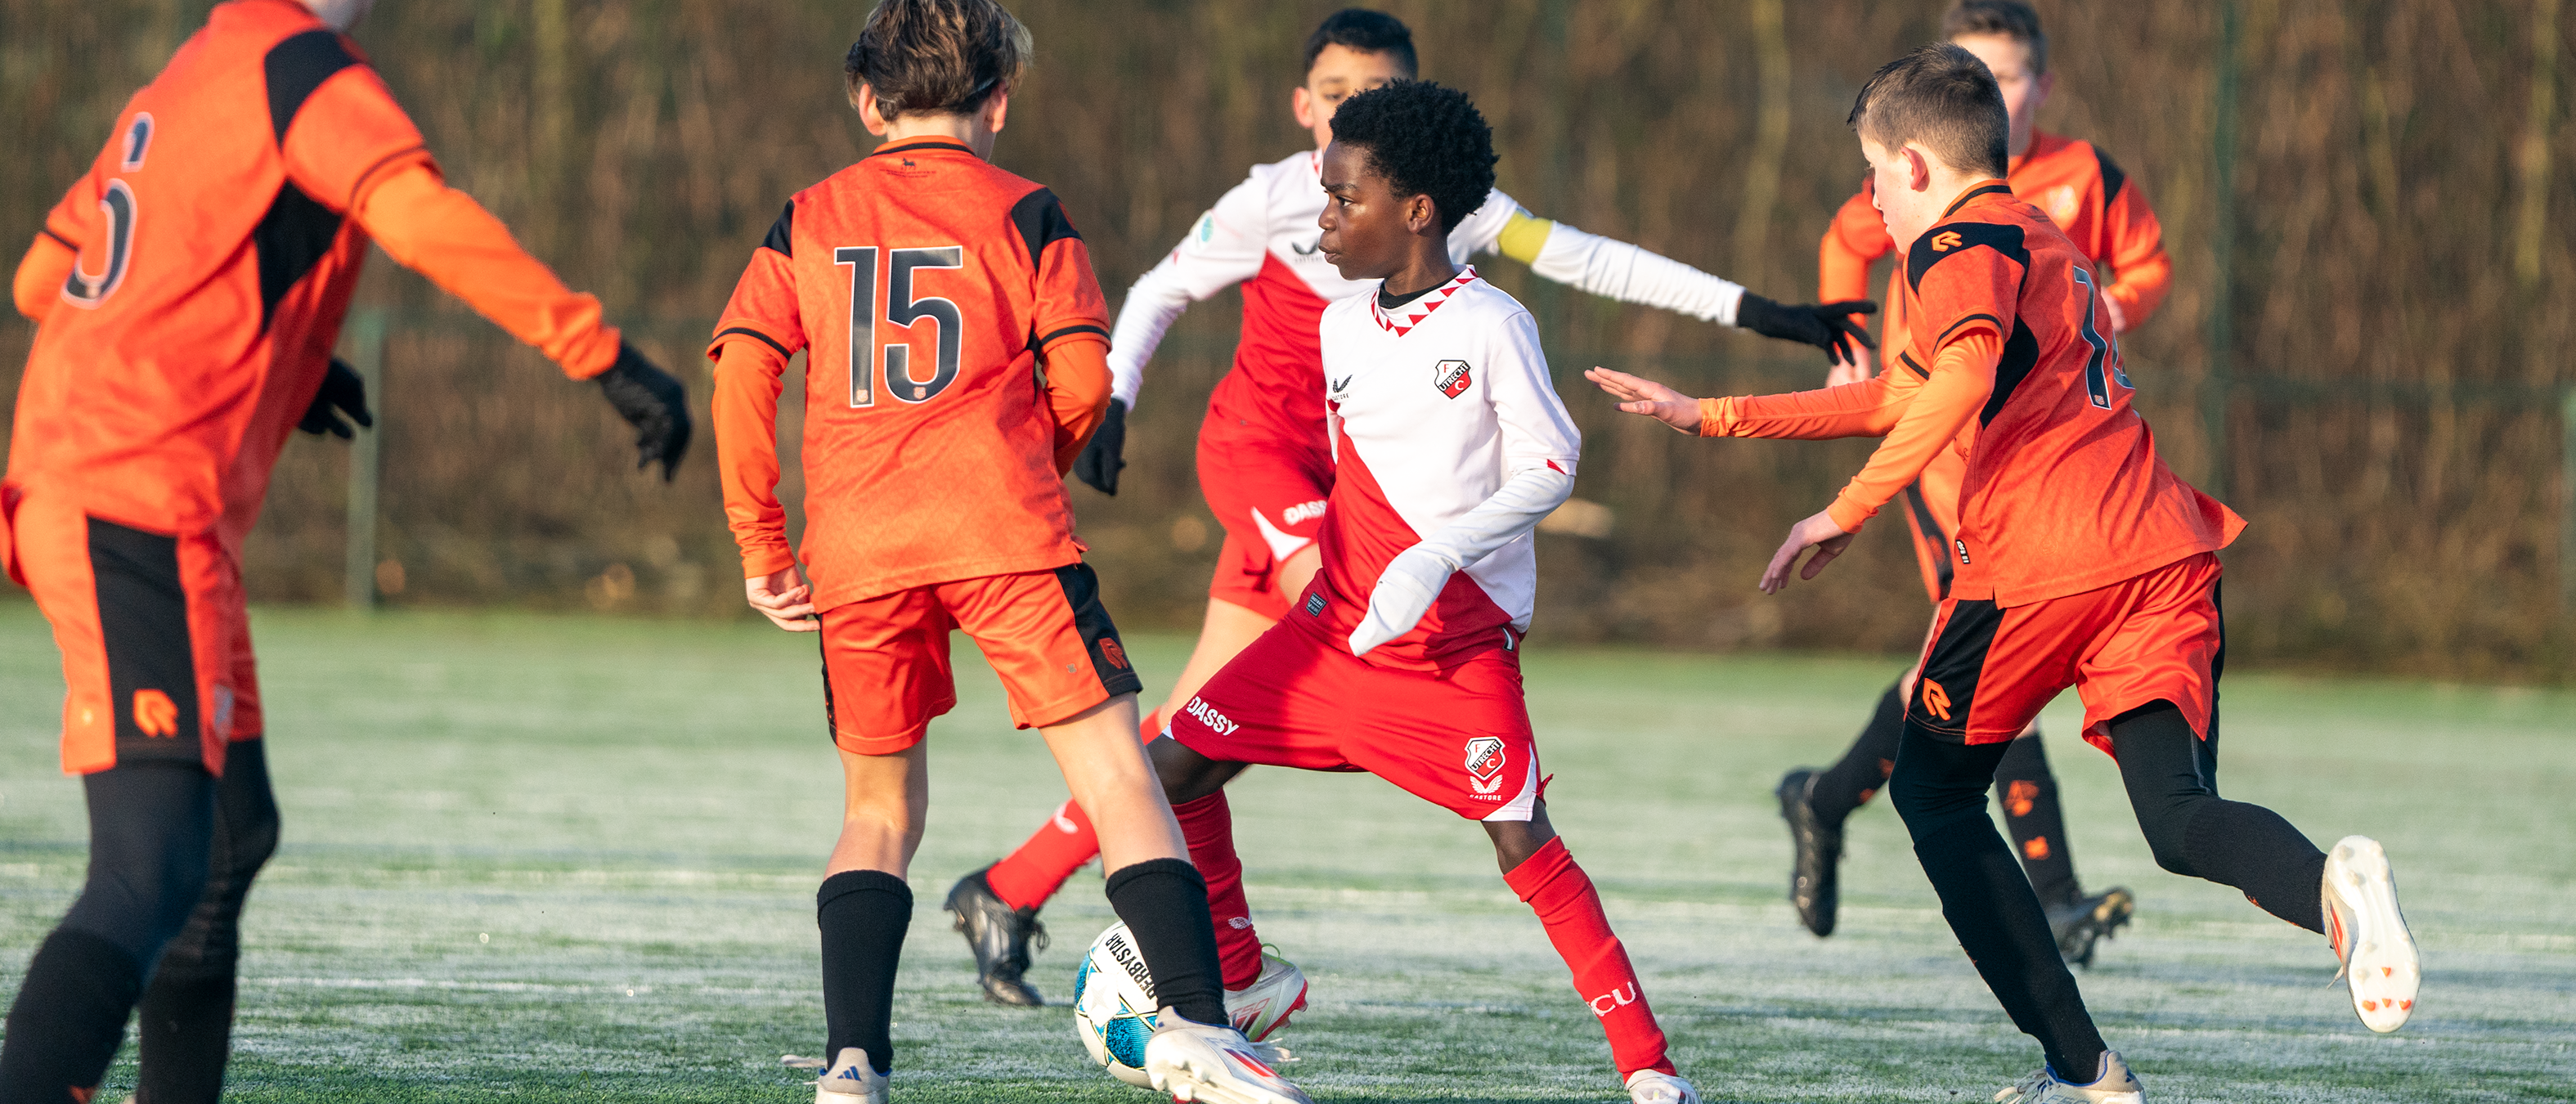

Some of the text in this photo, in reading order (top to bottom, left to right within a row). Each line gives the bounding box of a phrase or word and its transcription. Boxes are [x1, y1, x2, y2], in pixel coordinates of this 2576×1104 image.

[834, 245, 963, 408] 15
[2073, 265, 2137, 411] 1
[1438, 362, 1469, 392] UTRECHT
[1186, 695, 1240, 736] DASSY
[1470, 740, 1501, 771] UTRECHT
[1105, 932, 1156, 1000] DERBYSTAR
[1586, 981, 1636, 1017] CU
